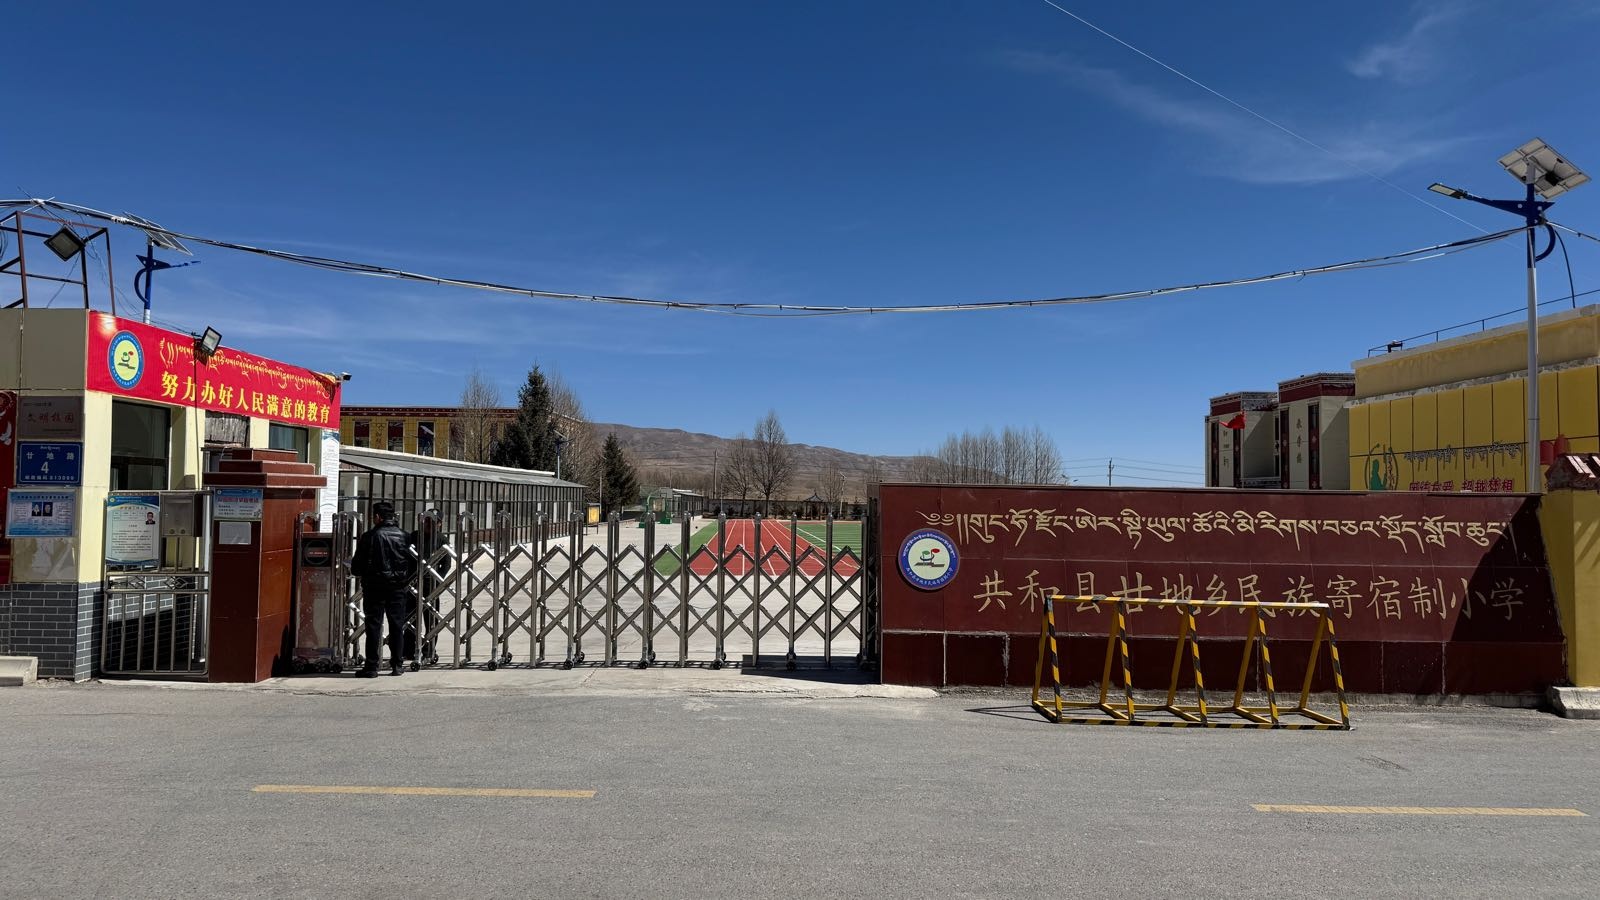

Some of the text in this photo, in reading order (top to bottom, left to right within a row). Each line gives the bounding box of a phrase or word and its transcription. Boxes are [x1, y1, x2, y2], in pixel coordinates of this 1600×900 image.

[161, 371, 330, 424] 努力办好人民满意的教育
[40, 461, 49, 474] 4
